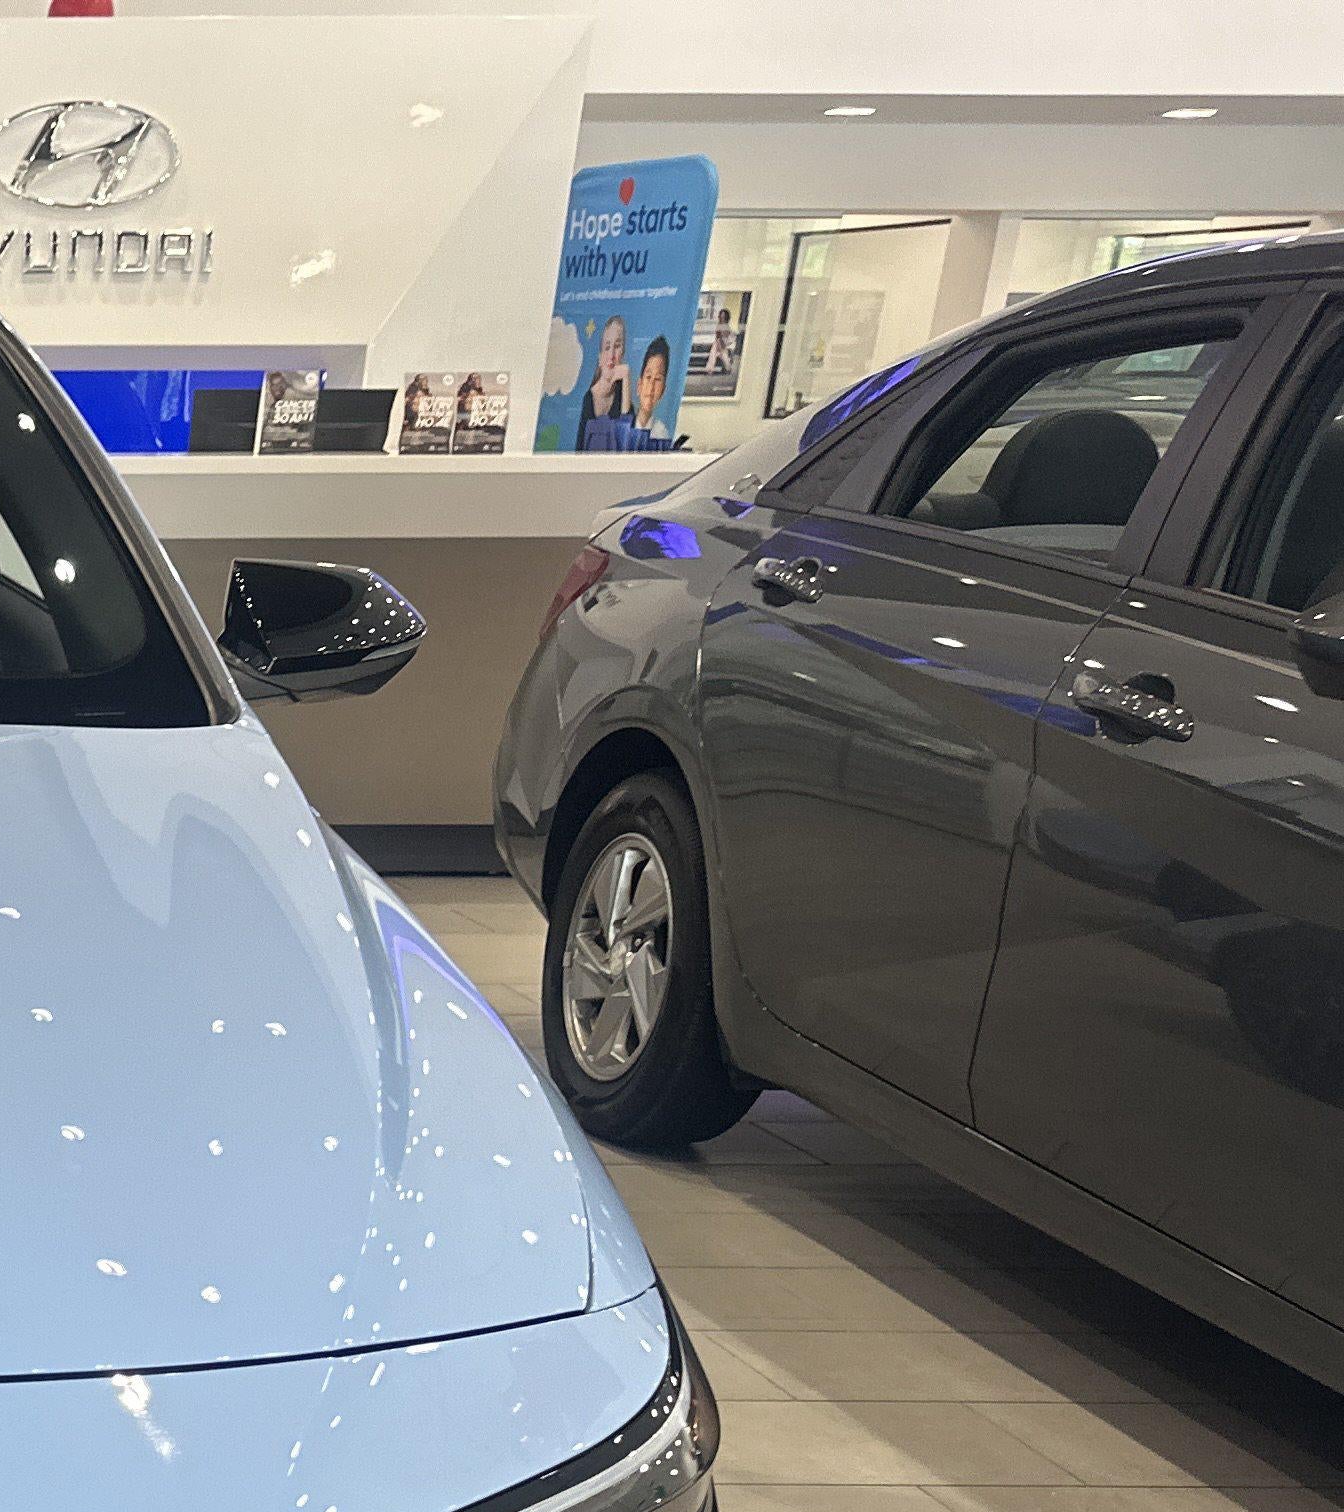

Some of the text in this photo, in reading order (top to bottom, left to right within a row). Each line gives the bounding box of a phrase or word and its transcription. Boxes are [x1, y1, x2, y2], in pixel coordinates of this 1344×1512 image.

[569, 201, 689, 246] Hope starts
[564, 245, 649, 284] with you
